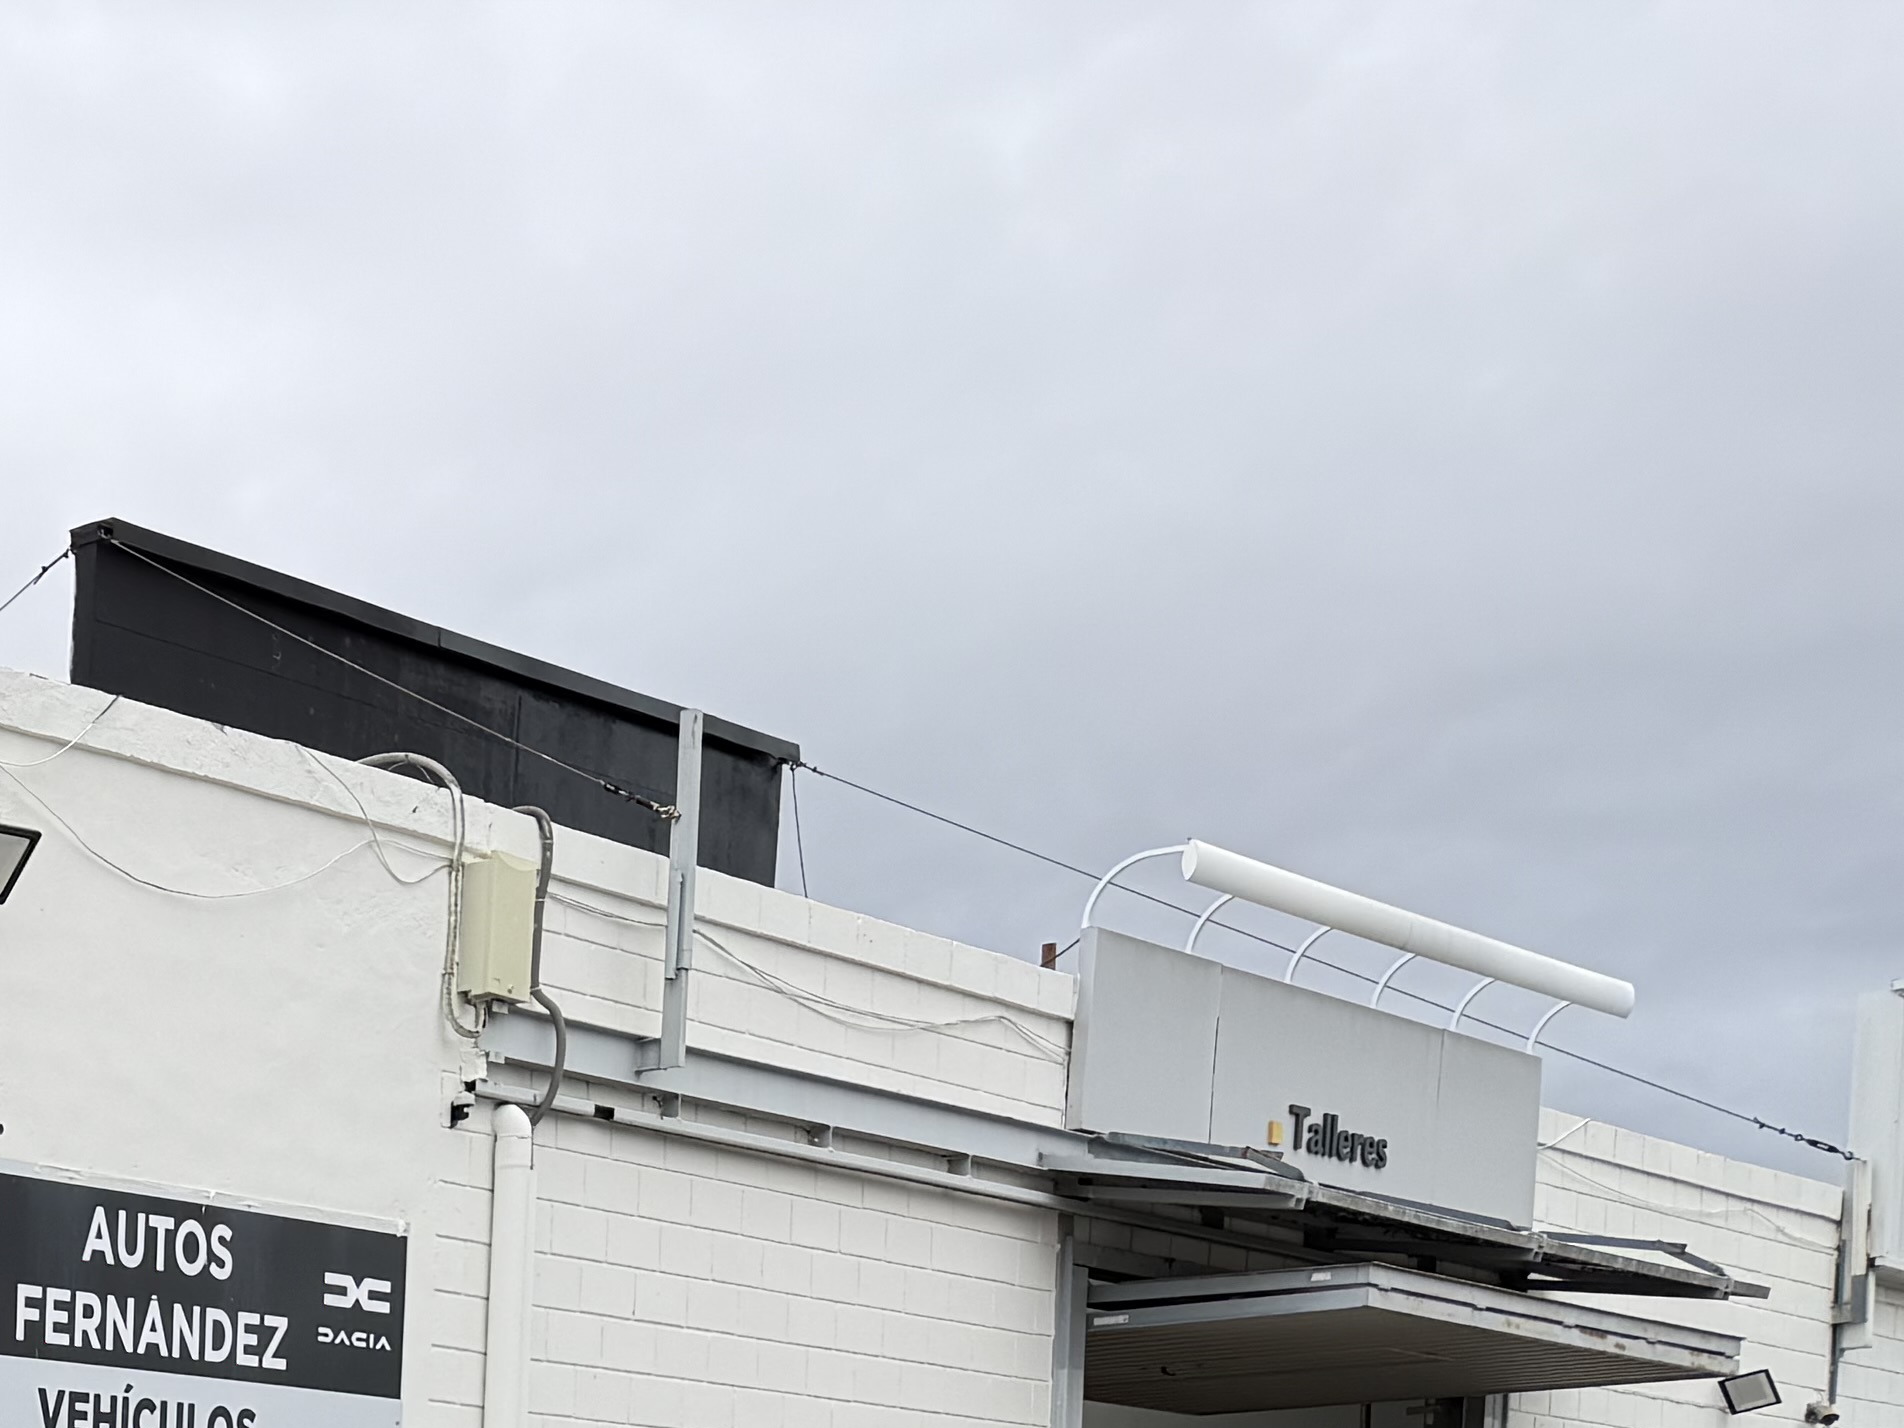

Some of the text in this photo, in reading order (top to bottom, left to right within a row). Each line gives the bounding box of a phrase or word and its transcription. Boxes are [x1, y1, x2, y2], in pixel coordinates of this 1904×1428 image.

[1288, 1104, 1388, 1169] Talleres
[82, 1206, 233, 1280] AUTOS
[317, 1326, 391, 1351] DACIA
